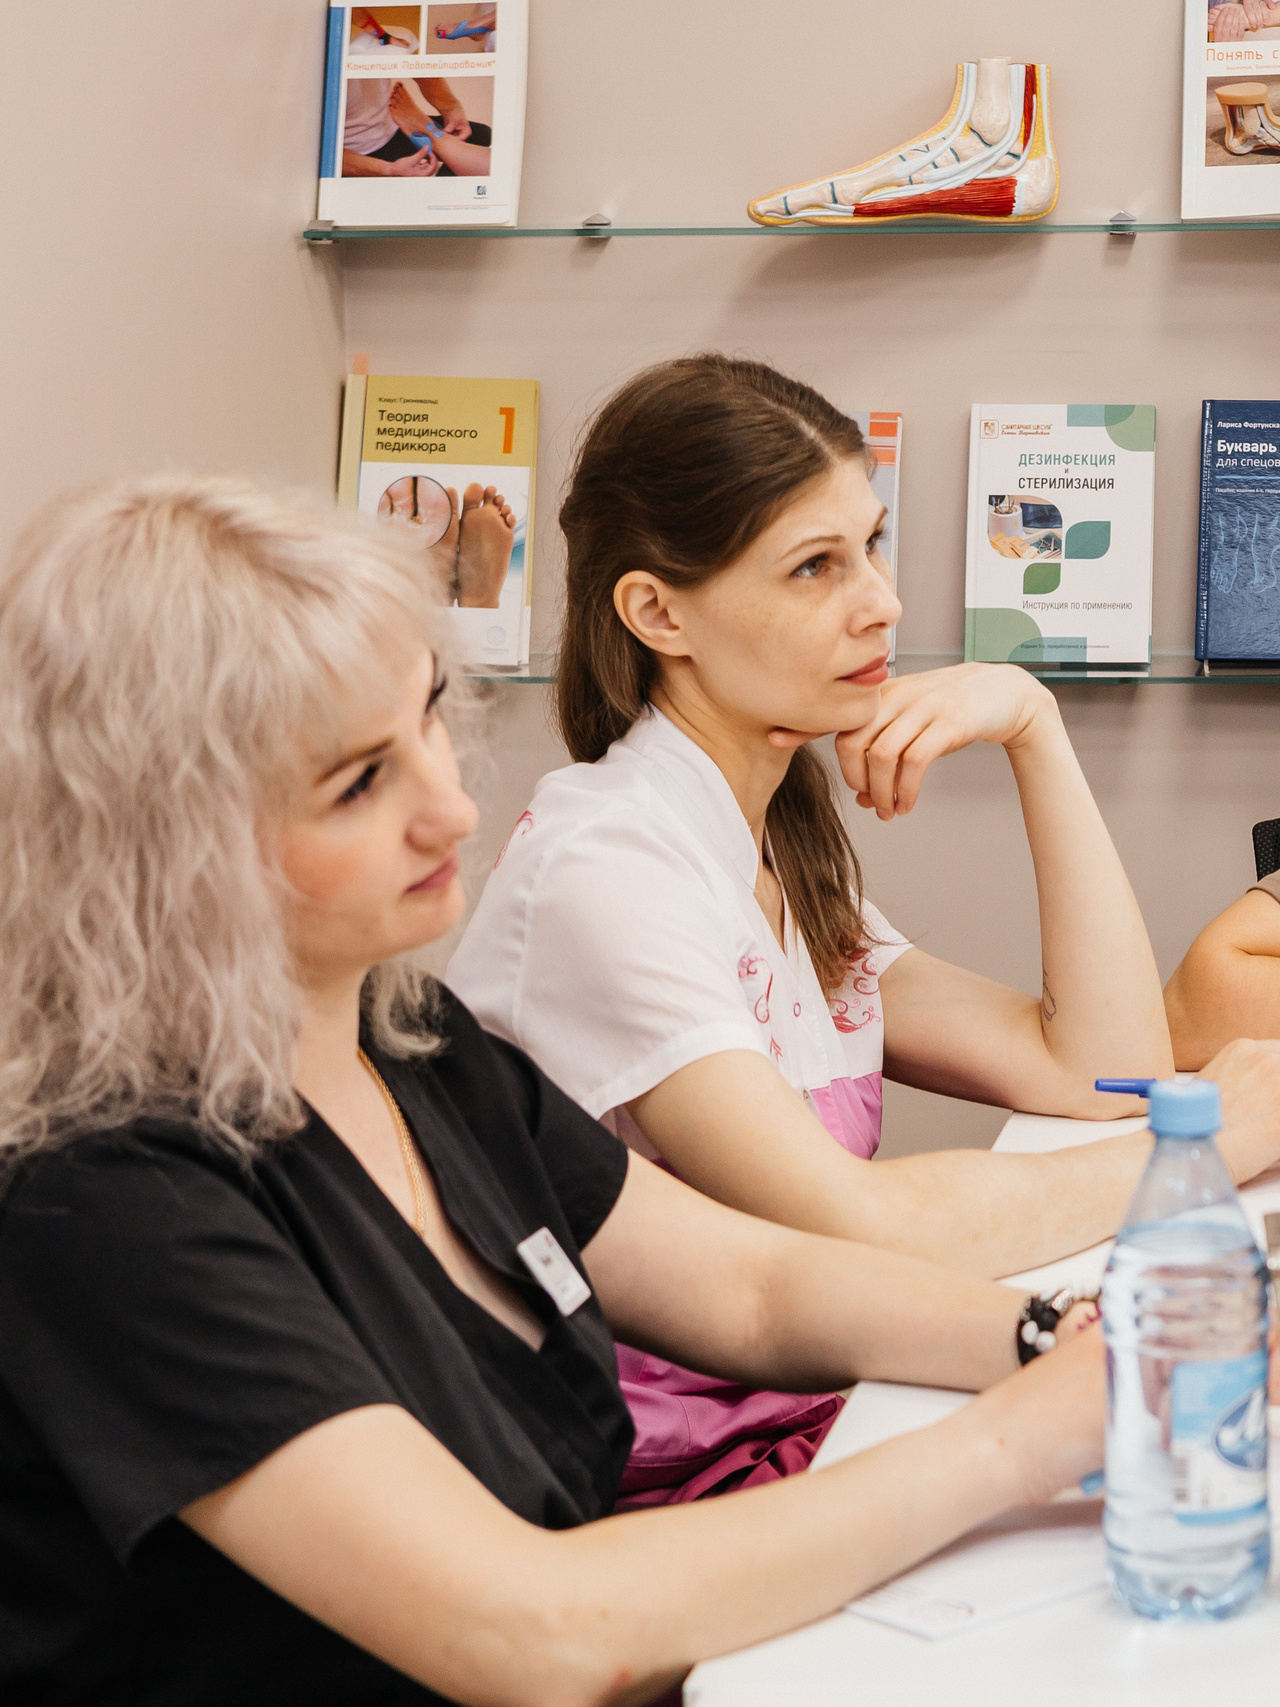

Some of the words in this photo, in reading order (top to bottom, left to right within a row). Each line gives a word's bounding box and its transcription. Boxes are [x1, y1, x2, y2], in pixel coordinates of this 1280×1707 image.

[1206, 48, 1263, 61] Понять
[347, 61, 398, 71] Концепция
[378, 409, 429, 424] Теория
[499, 406, 515, 454] 1
[1217, 421, 1242, 430] Лариса
[377, 427, 478, 439] медицинского
[376, 441, 446, 454] педикюра
[1217, 439, 1277, 455] Букварь
[1018, 453, 1116, 467] ДЕЗИНФЕКЦИЯ
[1216, 458, 1238, 468] для
[1240, 458, 1280, 469] спецов
[1018, 477, 1115, 491] СТЕРИЛИЗАЦИЯ
[1022, 600, 1069, 611] Инструкция
[1070, 602, 1080, 610] по
[1083, 602, 1133, 611] применению
